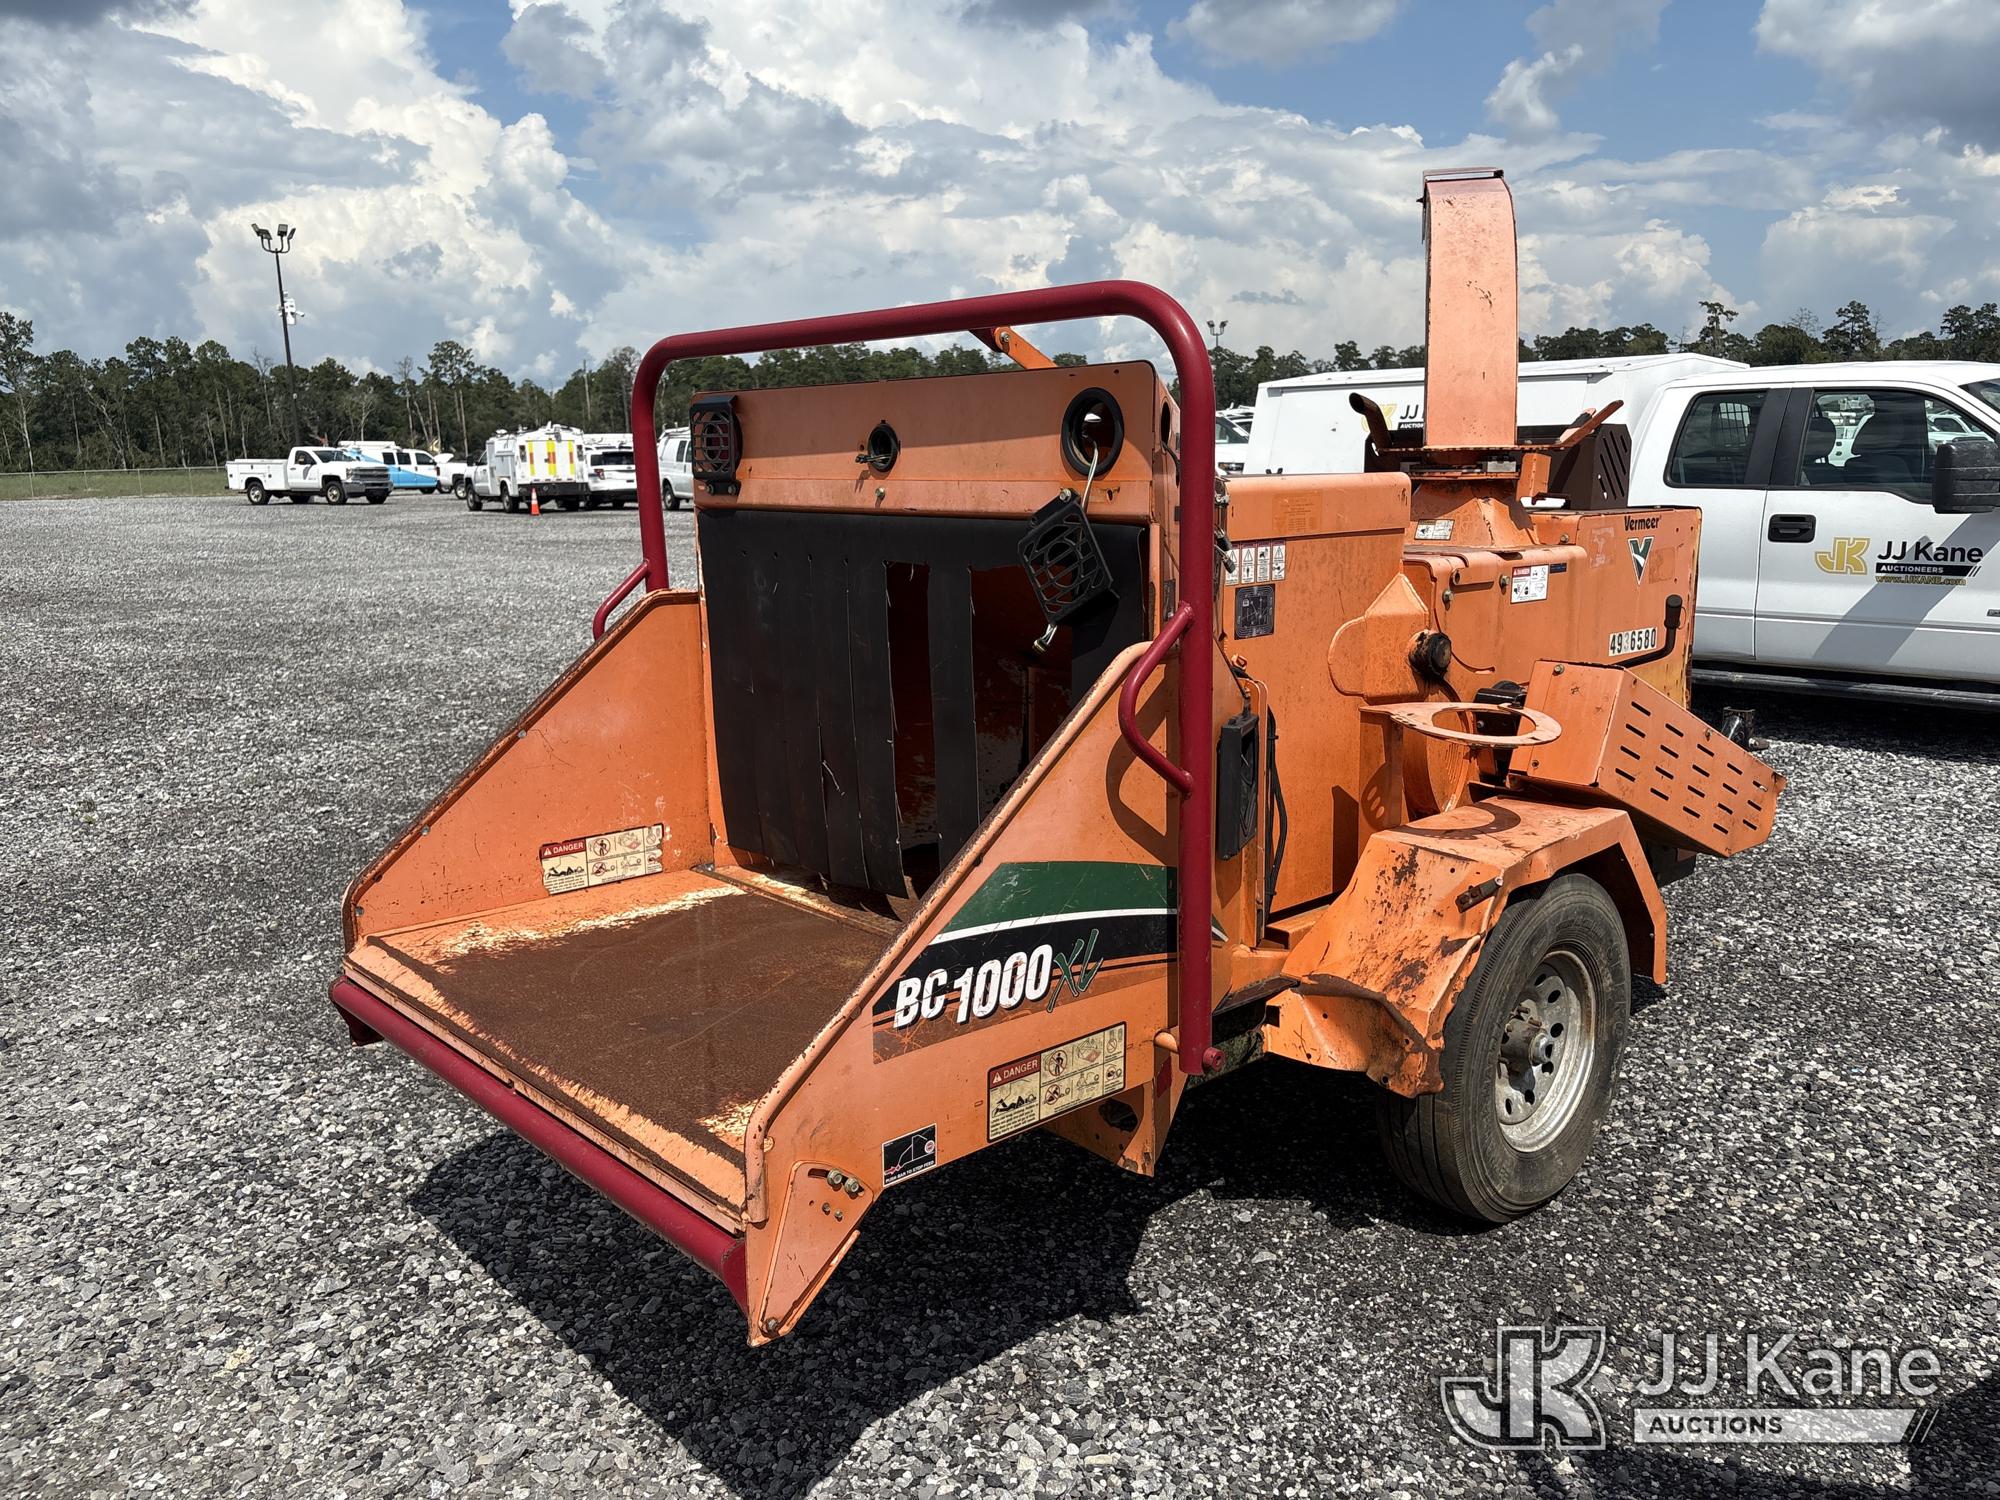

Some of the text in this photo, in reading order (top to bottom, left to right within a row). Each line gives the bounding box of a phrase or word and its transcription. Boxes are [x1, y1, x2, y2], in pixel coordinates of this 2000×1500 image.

[1400, 404, 1419, 419] JJ
[1624, 515, 1661, 531] Vermeer
[1876, 541, 1984, 563] JJ Kane
[1880, 565, 1944, 574] AUCTIONEERS
[552, 841, 584, 854] DANGER
[1003, 1059, 1038, 1079] DANGER
